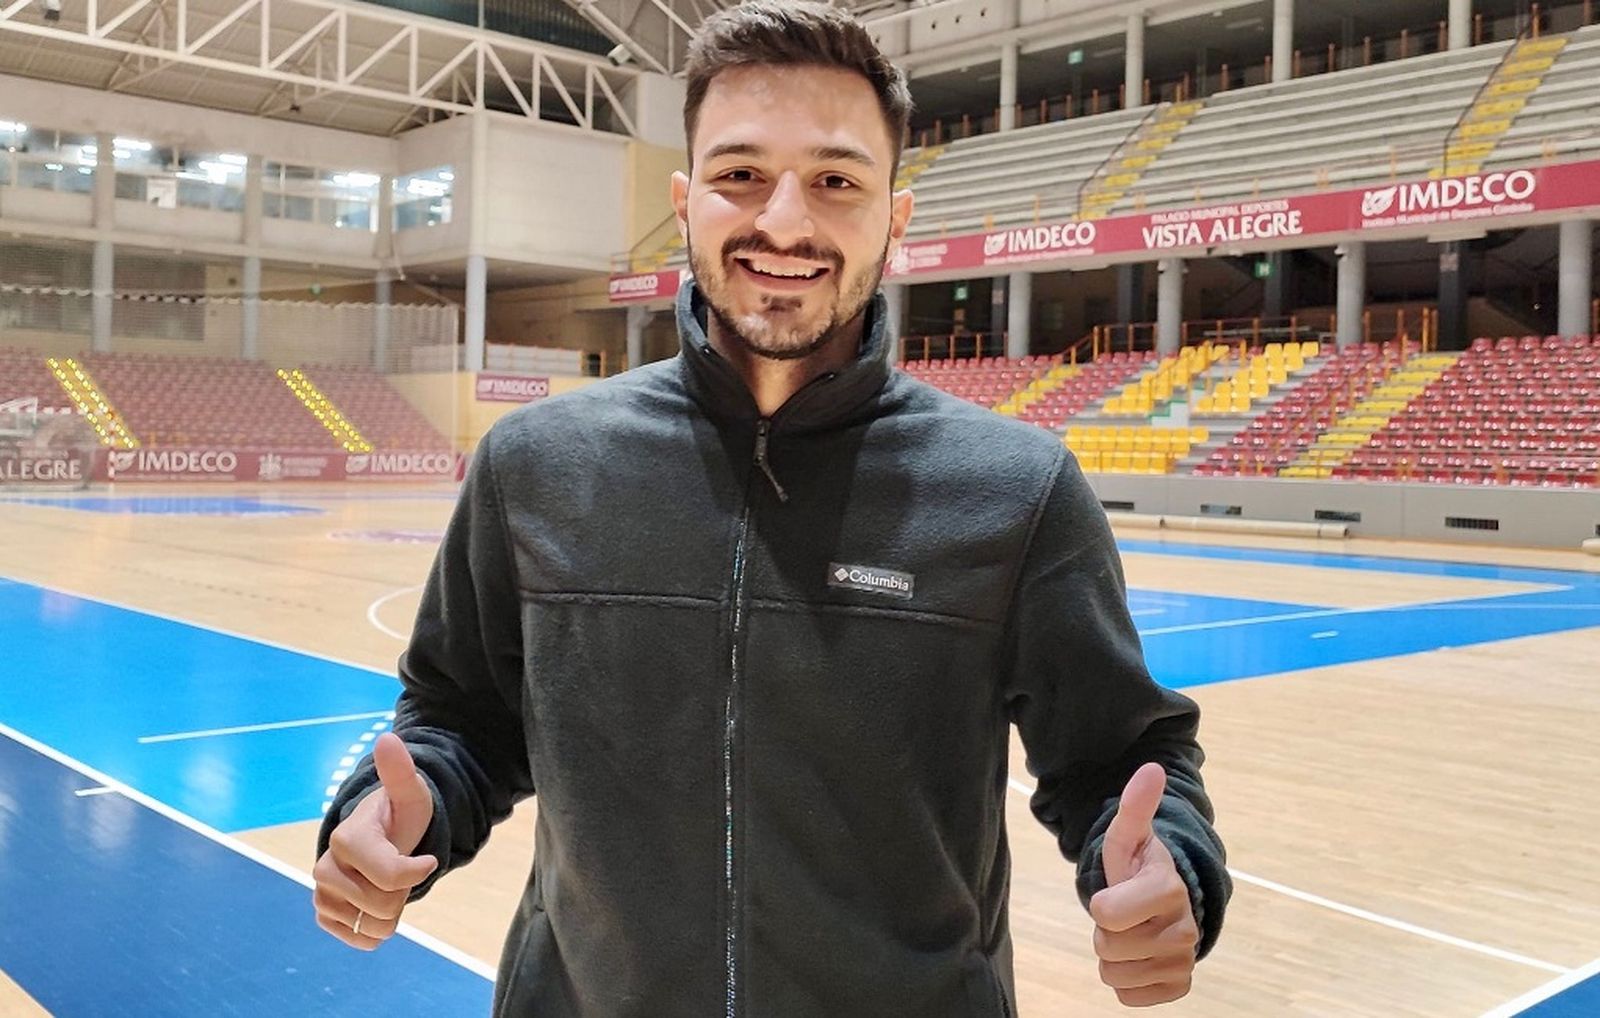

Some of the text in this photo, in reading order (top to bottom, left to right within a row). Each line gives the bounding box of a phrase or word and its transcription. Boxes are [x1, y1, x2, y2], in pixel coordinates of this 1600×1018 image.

[1400, 170, 1536, 212] IMDECO
[1008, 221, 1096, 252] IMDECO
[1142, 210, 1303, 248] VISTA ALEGRE
[138, 451, 237, 473] IMDECO
[371, 453, 451, 474] IMDECO
[849, 569, 910, 591] Columbia
